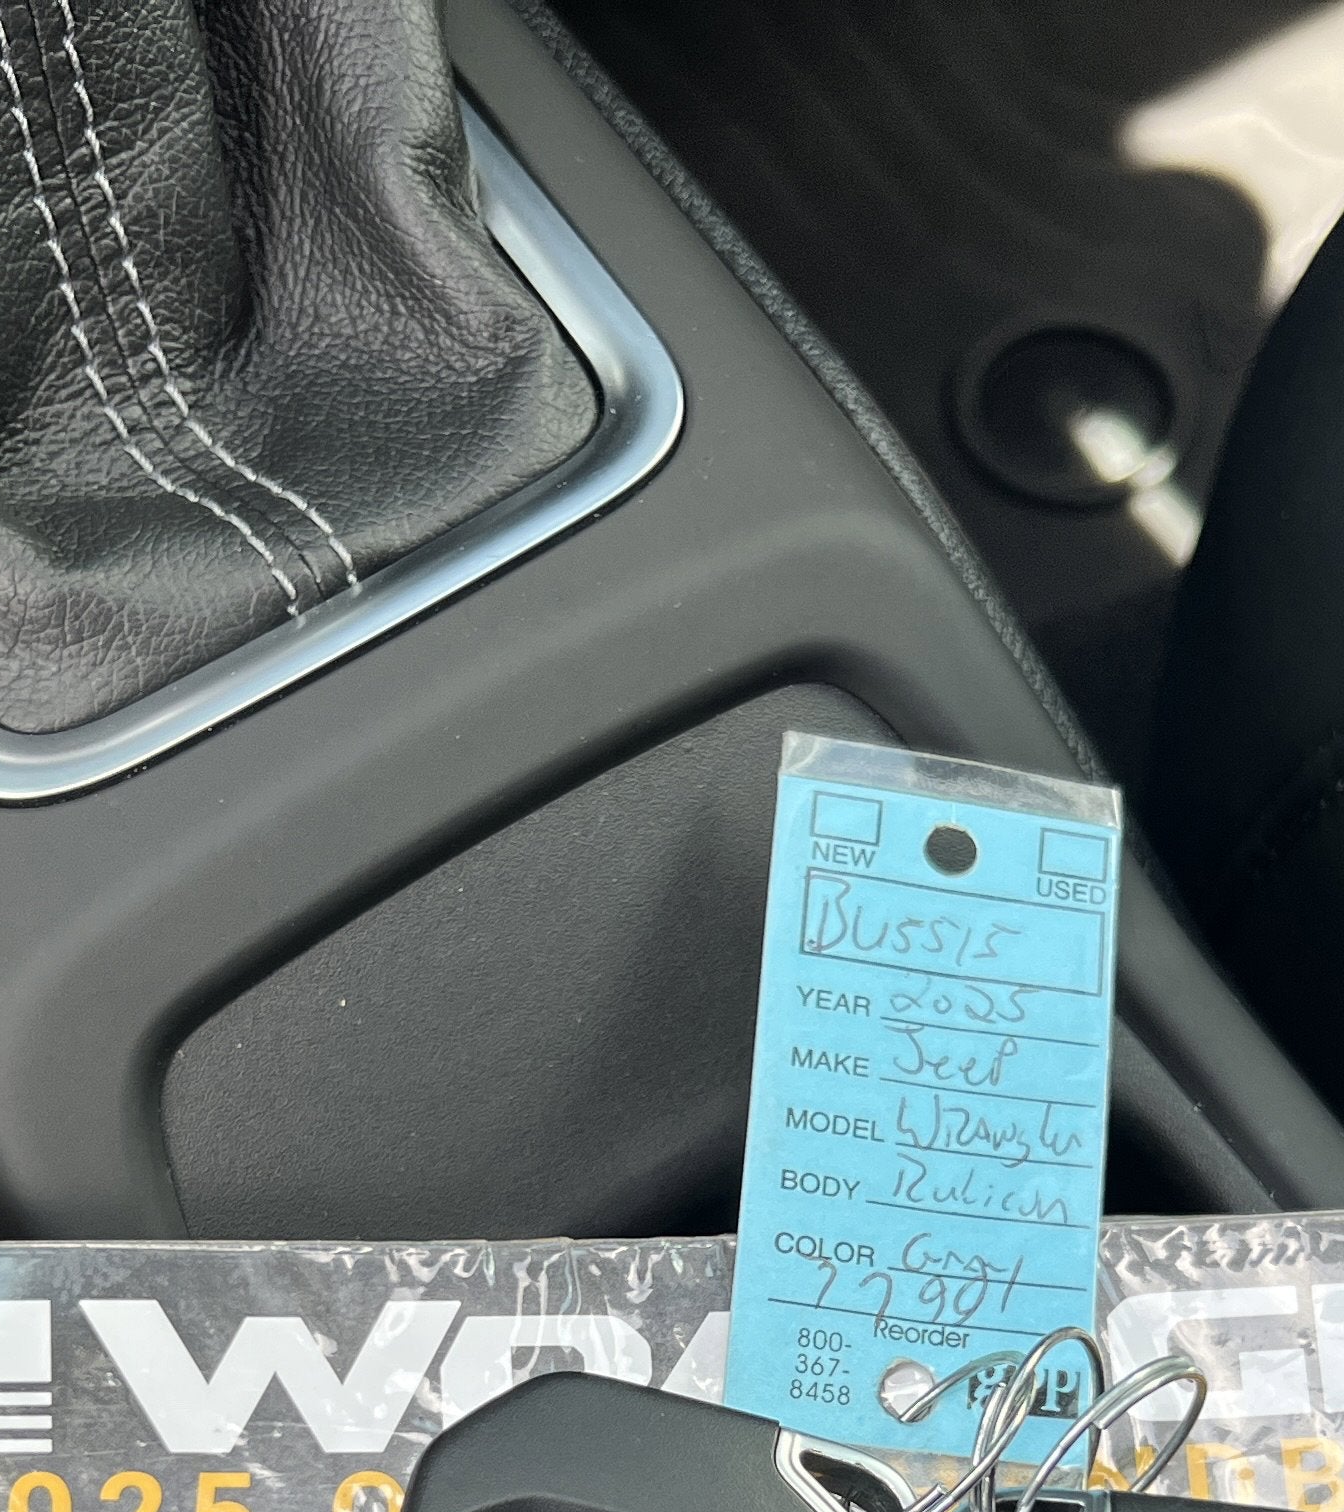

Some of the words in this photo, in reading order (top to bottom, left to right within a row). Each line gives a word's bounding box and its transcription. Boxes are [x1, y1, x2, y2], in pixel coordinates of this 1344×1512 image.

[811, 840, 877, 869] NEW
[1035, 877, 1107, 906] USED
[796, 985, 873, 1018] YEAR
[889, 977, 1039, 1024] 2025
[790, 1046, 871, 1079] MAKE
[784, 1106, 886, 1143] MODEL
[779, 1168, 862, 1200] BODY
[773, 1231, 876, 1268] COLOR
[797, 1328, 853, 1353] 800-
[873, 1318, 971, 1350] Reorder
[794, 1353, 851, 1378] 367-
[788, 1380, 851, 1406] 8458
